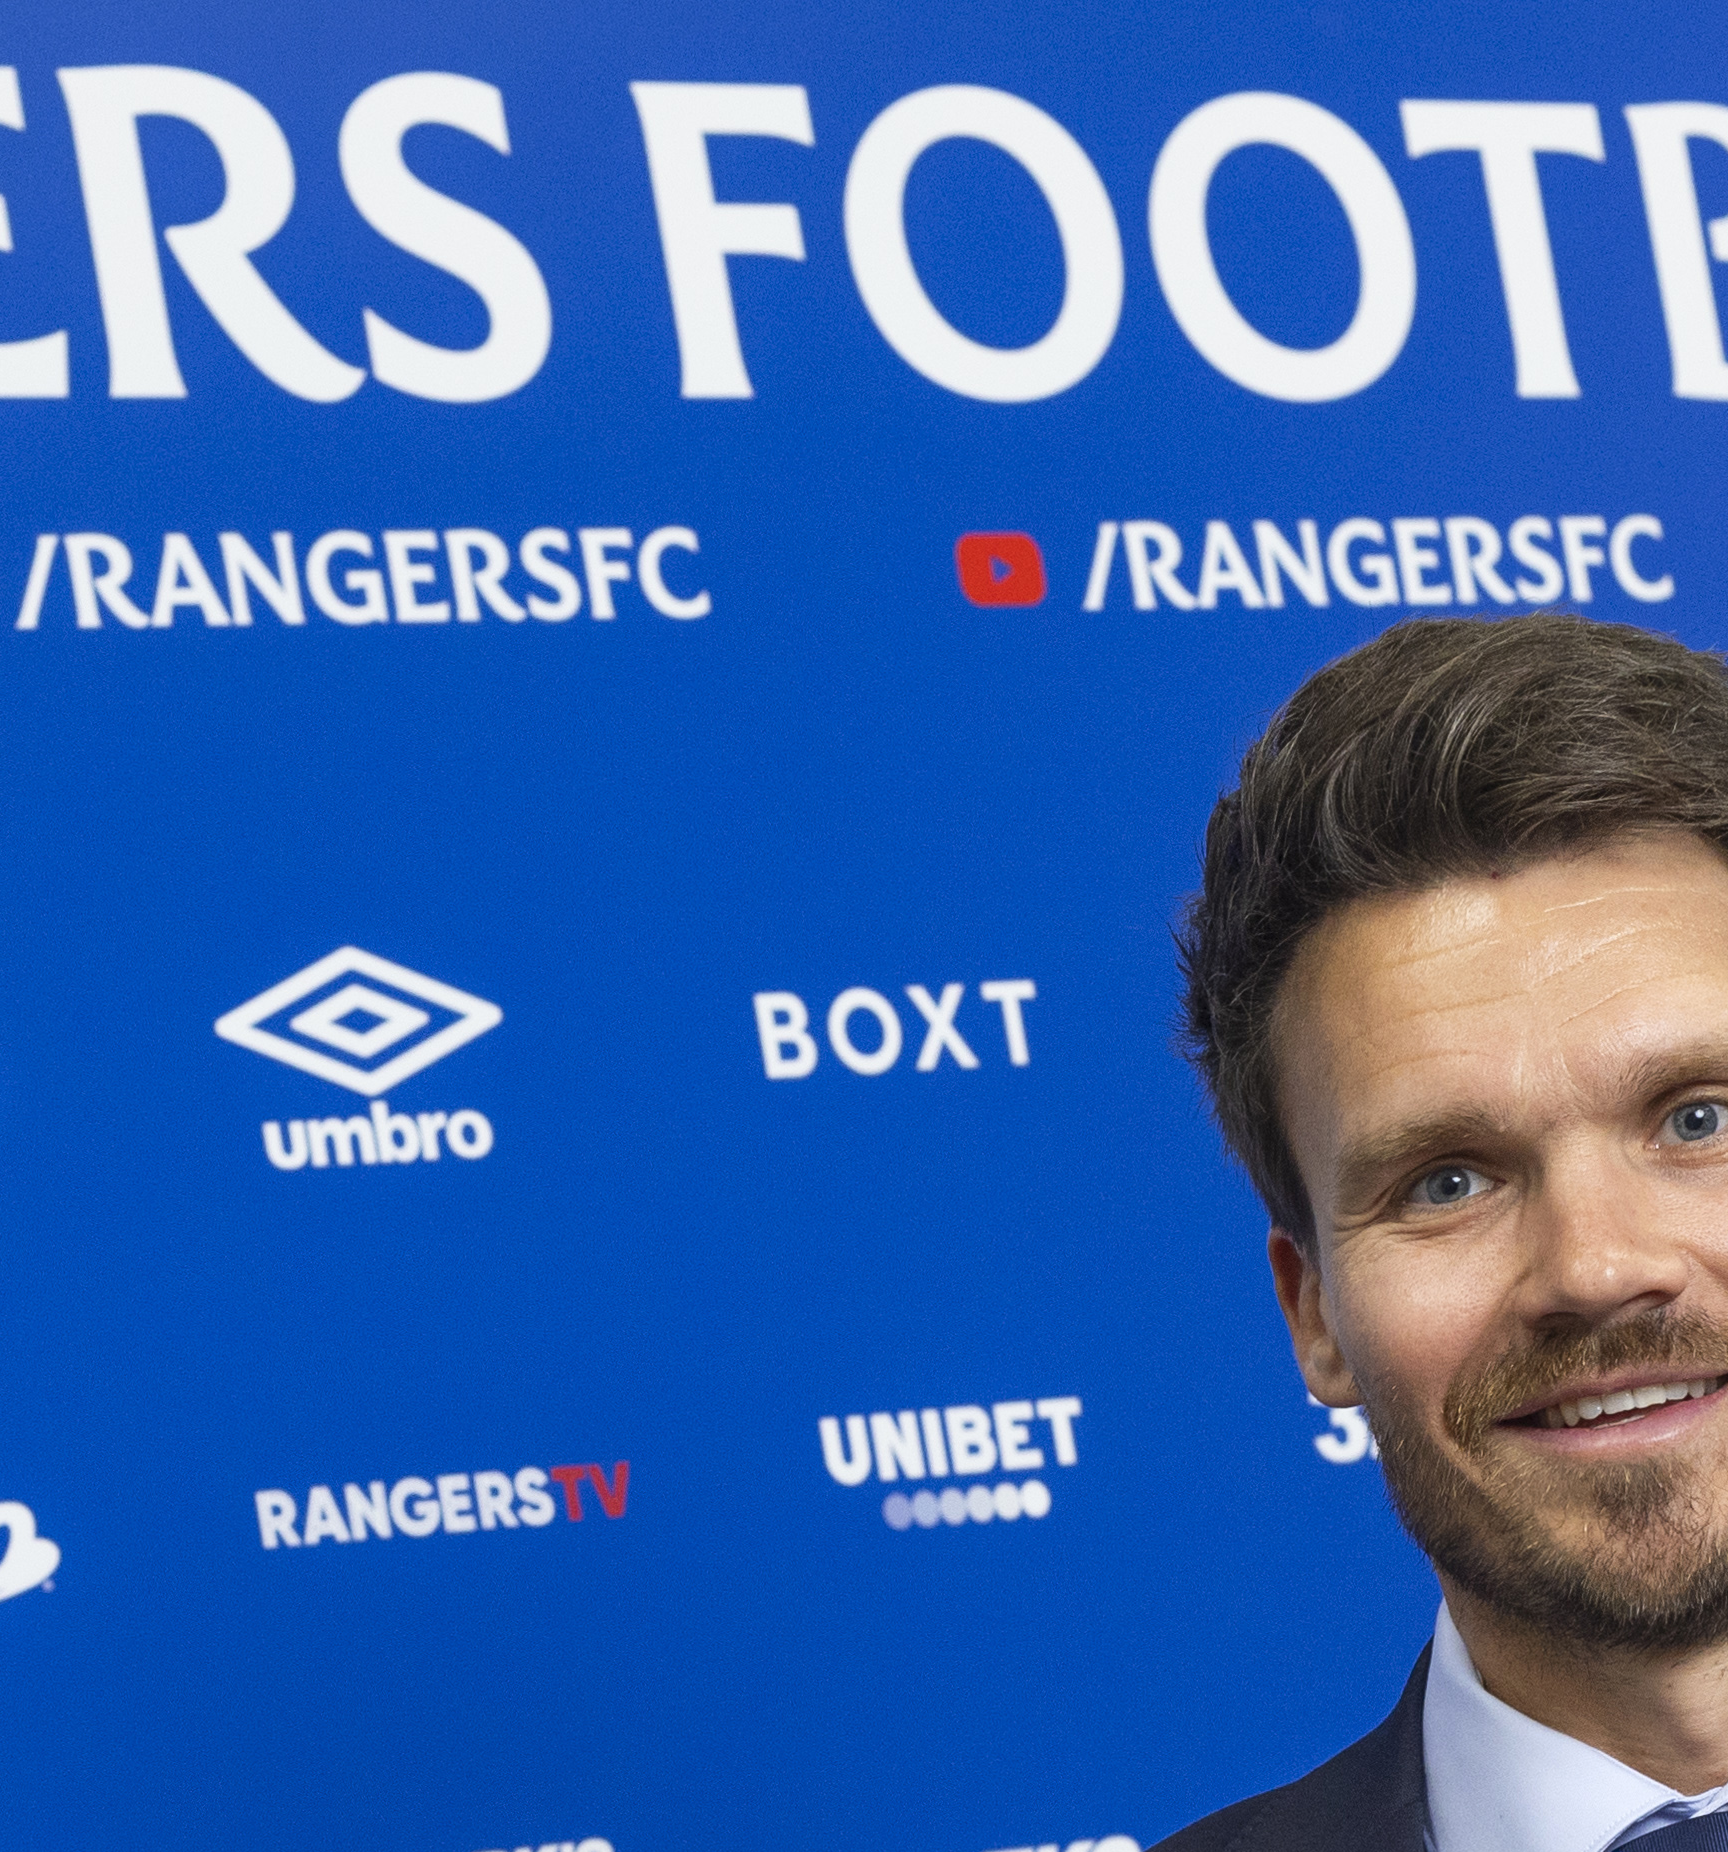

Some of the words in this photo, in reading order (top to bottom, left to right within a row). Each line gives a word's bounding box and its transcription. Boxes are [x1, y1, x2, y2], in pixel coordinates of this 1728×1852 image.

[15, 525, 712, 631] /RANGERSFC
[1083, 513, 1675, 611] /RANGERSFC
[753, 979, 1037, 1080] BOXT
[261, 1099, 494, 1171] umbro
[818, 1396, 1082, 1488] UNIBET
[253, 1461, 630, 1551] RANGERSTV
